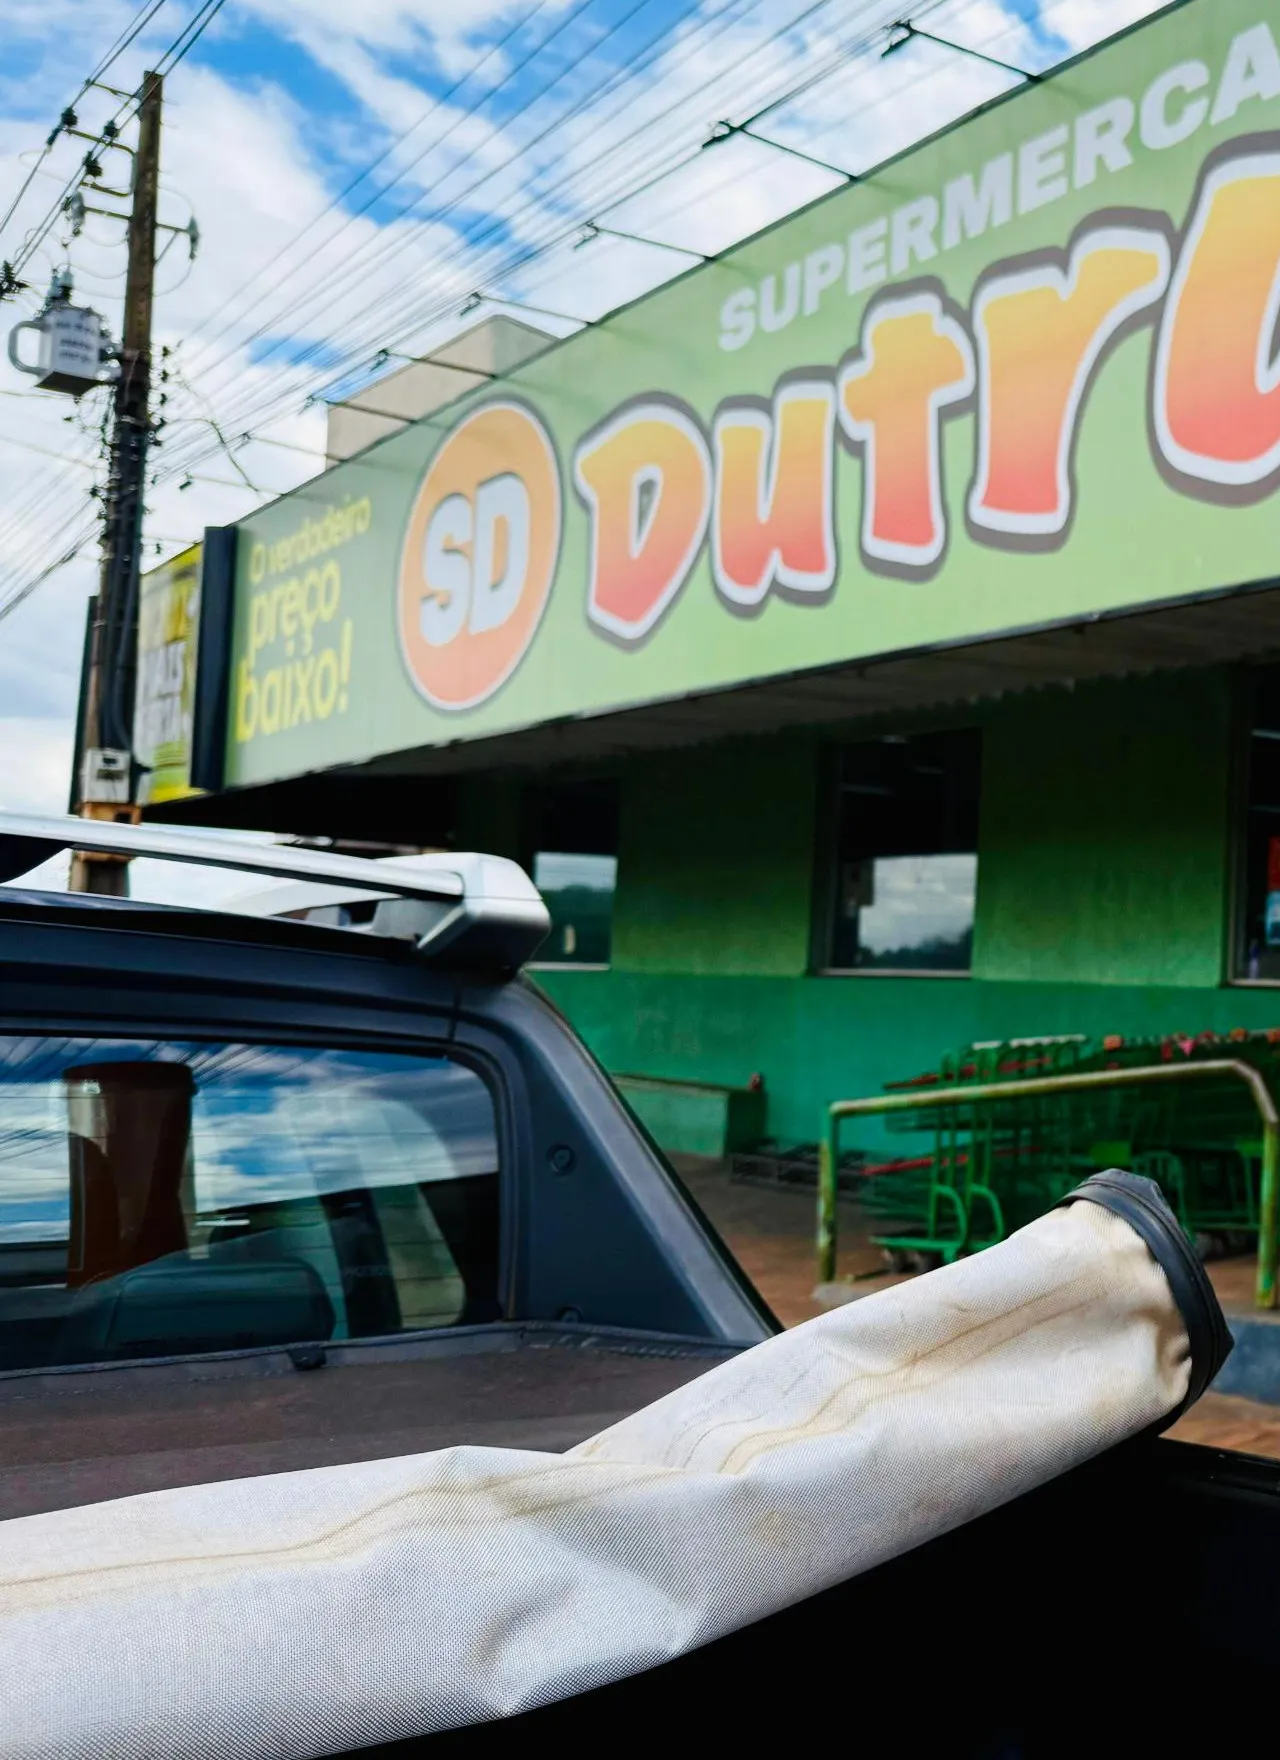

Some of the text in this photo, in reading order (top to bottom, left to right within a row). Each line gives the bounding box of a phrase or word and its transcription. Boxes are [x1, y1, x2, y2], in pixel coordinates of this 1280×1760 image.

[247, 559, 341, 671] preço
[250, 543, 267, 584] O
[419, 471, 530, 648] SD
[236, 617, 353, 742] baixo!
